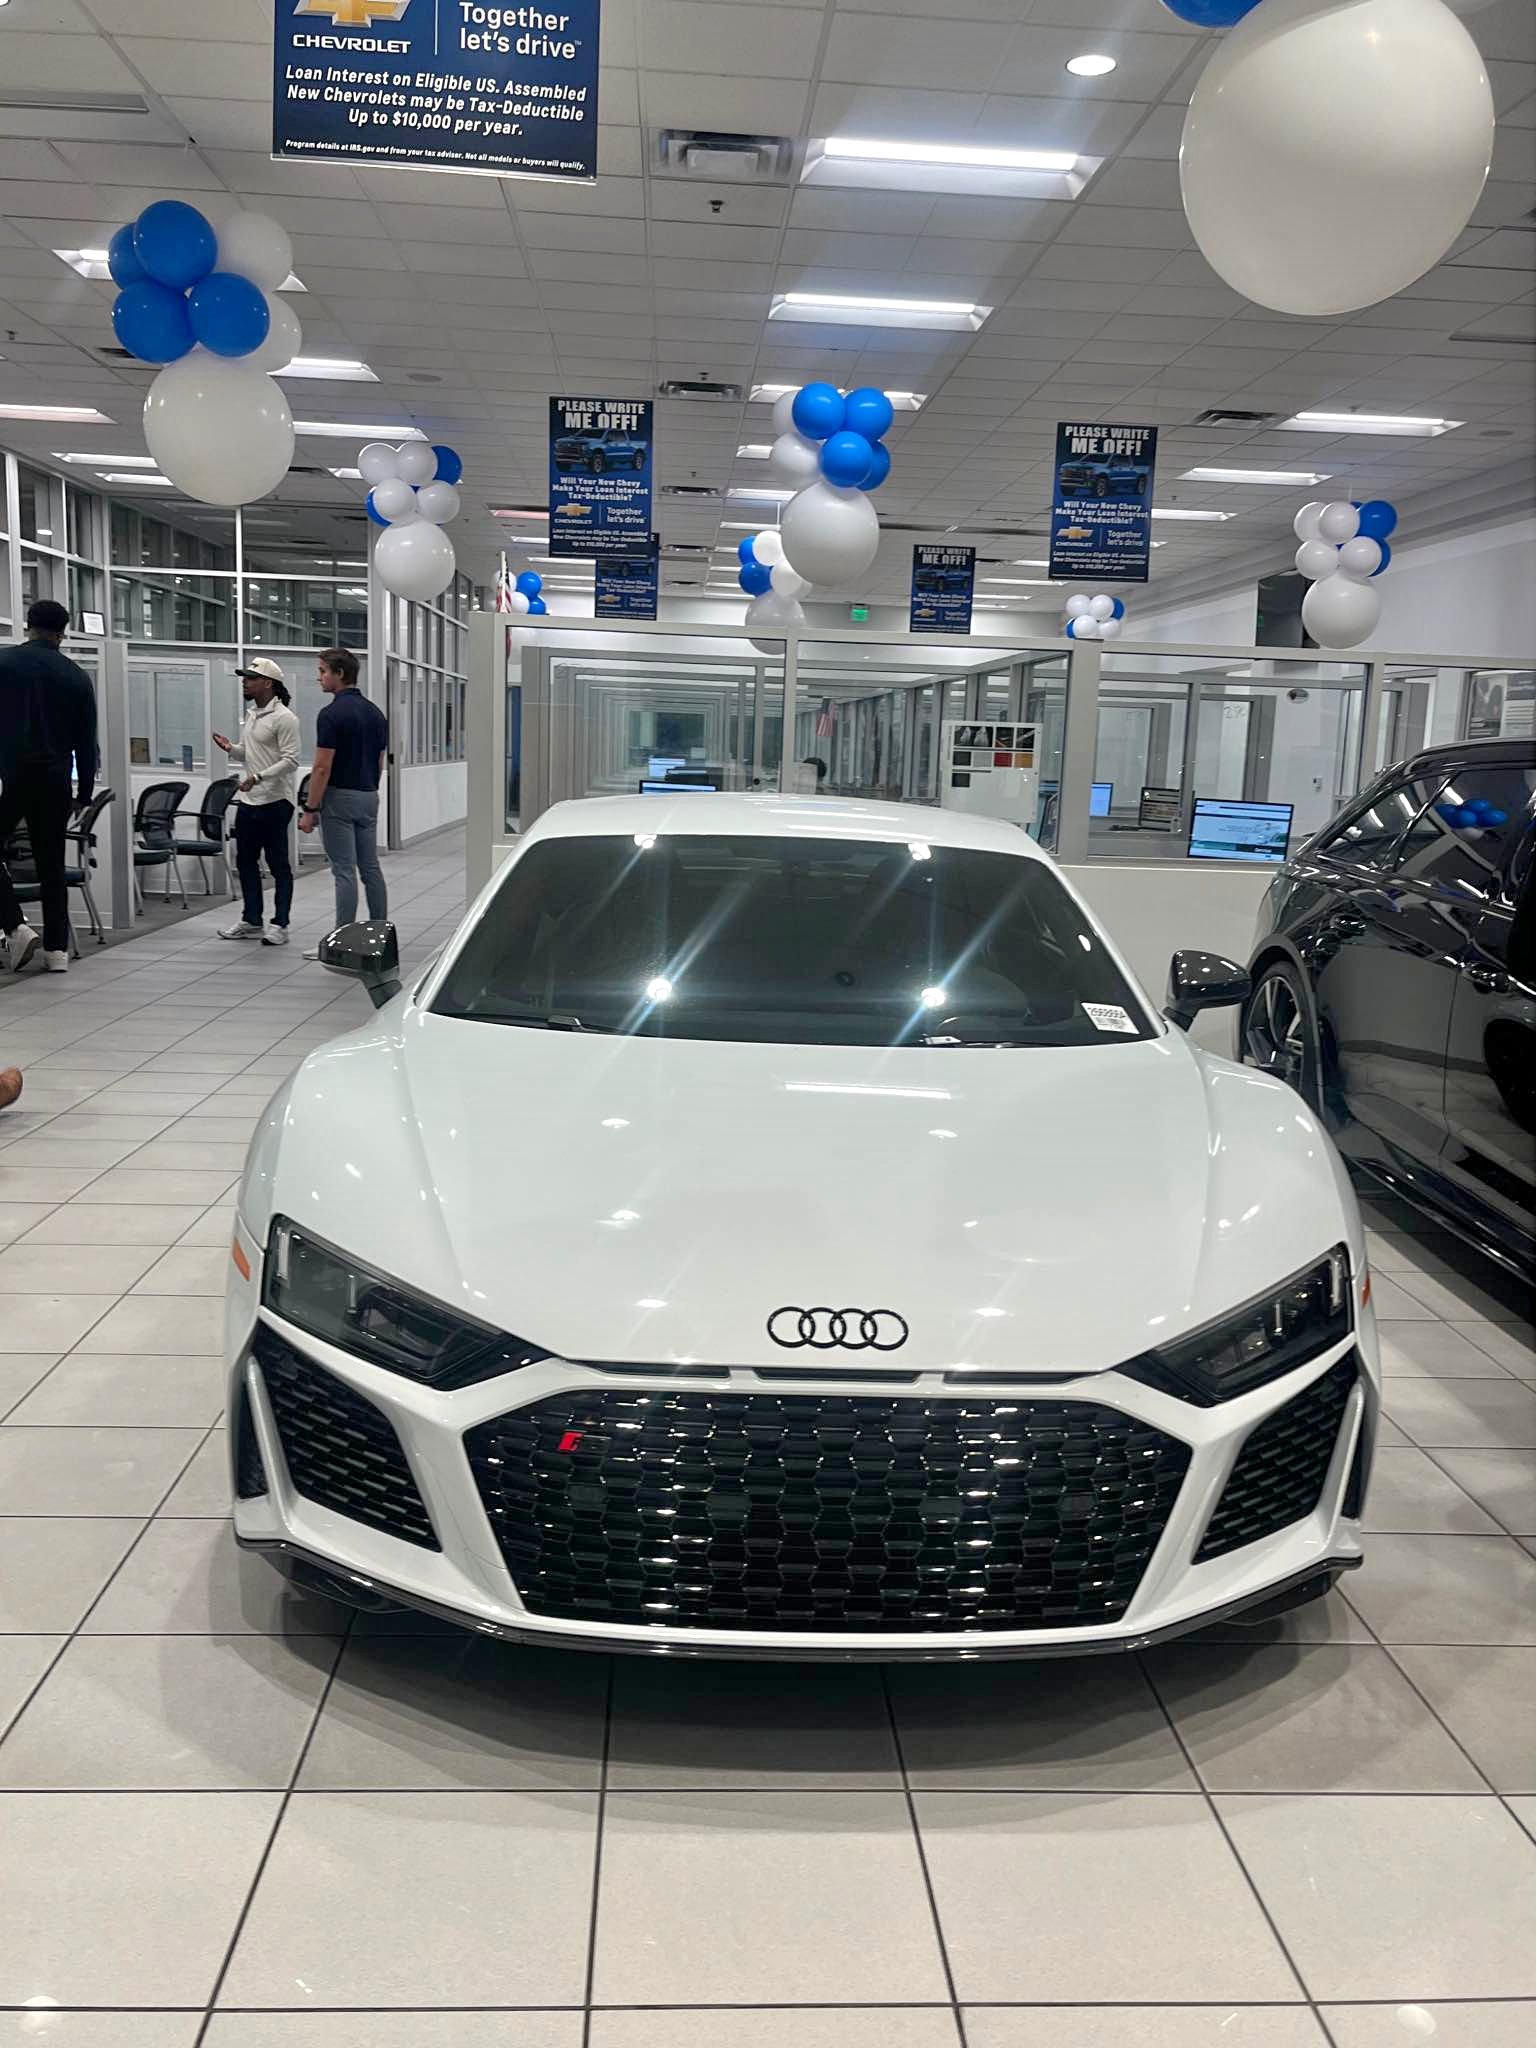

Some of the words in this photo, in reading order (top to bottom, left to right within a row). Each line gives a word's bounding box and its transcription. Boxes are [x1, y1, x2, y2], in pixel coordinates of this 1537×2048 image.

[459, 2, 569, 31] Together
[292, 34, 411, 53] CHEVROLET
[460, 28, 510, 53] let's
[286, 65, 322, 81] Loan
[327, 67, 389, 85] Interest
[393, 74, 411, 86] on
[415, 73, 472, 92] Eligible
[476, 78, 500, 93] US.
[504, 80, 586, 101] Assembled
[287, 85, 320, 100] New
[324, 87, 406, 106] Chevrolets
[410, 94, 443, 112] may
[446, 95, 464, 110] be
[469, 97, 584, 121] Tax-Deductible
[348, 109, 368, 127] Up
[373, 112, 388, 125] to
[392, 112, 451, 129] $10,000
[454, 119, 481, 134] per
[483, 121, 523, 136] year.
[286, 139, 315, 150] Program
[317, 142, 340, 150] details
[350, 144, 375, 154] IRS.gov
[376, 146, 389, 154] and
[390, 146, 407, 155] from
[407, 149, 424, 157] your
[465, 152, 478, 161] Not
[478, 153, 488, 161] all
[488, 155, 512, 163] models
[522, 157, 546, 167] buyers
[546, 159, 560, 167] will
[560, 161, 585, 170] qualify.
[558, 400, 602, 412] PLEASE
[604, 402, 645, 414] WRITE
[565, 412, 592, 428] ME
[597, 413, 638, 431] OFF!
[1065, 426, 1108, 437] PLEASE
[1110, 428, 1149, 439] WRITE
[1071, 438, 1098, 453] ME
[1103, 439, 1142, 456] OFF!
[552, 484, 573, 492] Make
[616, 479, 640, 488] Chevy
[607, 507, 642, 516] Together
[1077, 508, 1096, 516] Your
[1081, 501, 1099, 509] Your
[922, 554, 939, 564] ME
[942, 554, 966, 566] OFF!
